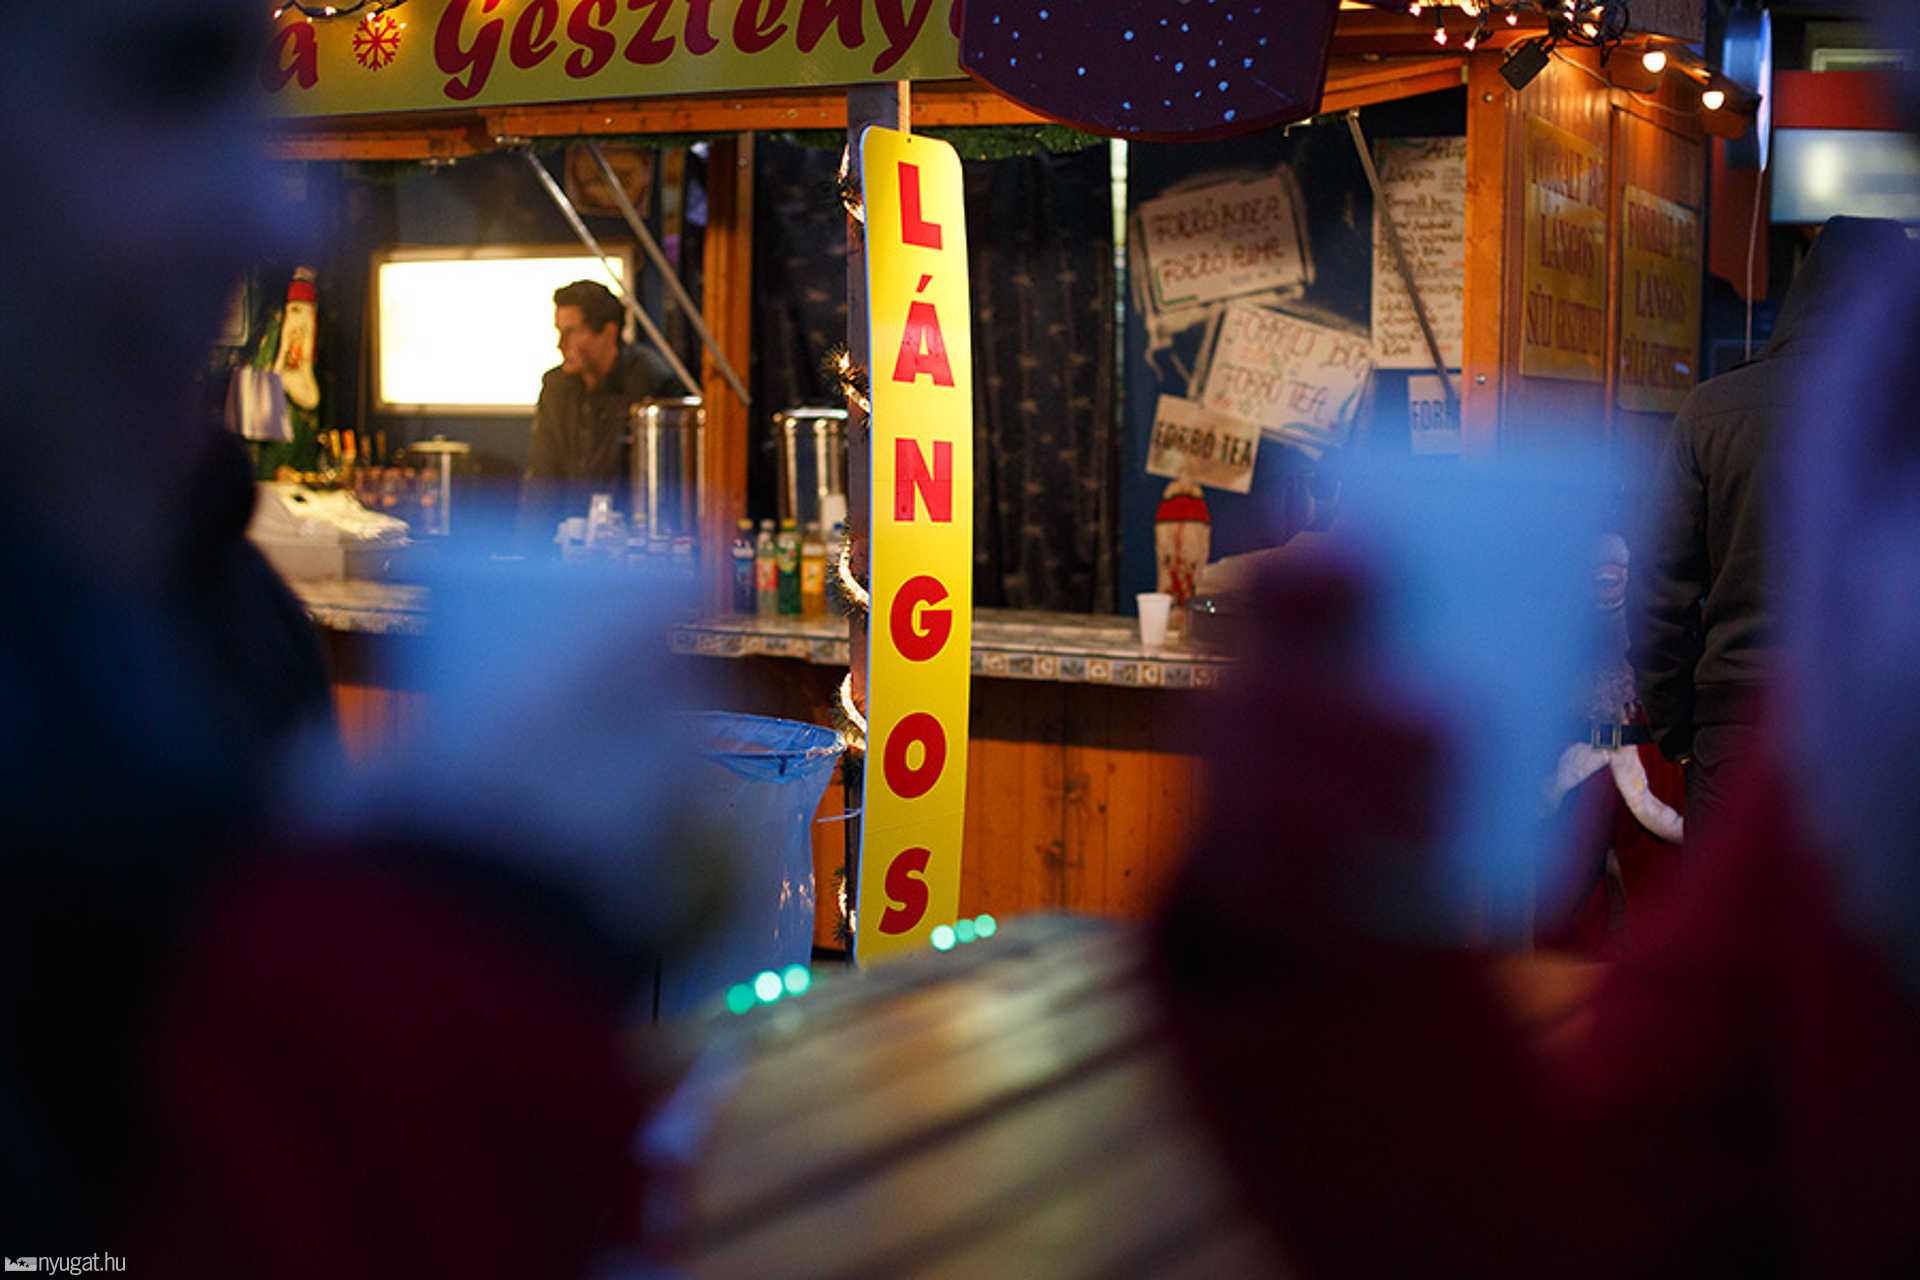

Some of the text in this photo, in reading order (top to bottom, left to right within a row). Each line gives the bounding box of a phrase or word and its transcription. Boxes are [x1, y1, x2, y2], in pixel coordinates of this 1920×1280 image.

[434, 0, 961, 100] Geszteny
[1219, 433, 1252, 468] TEA
[879, 160, 955, 935] LÁNGOS
